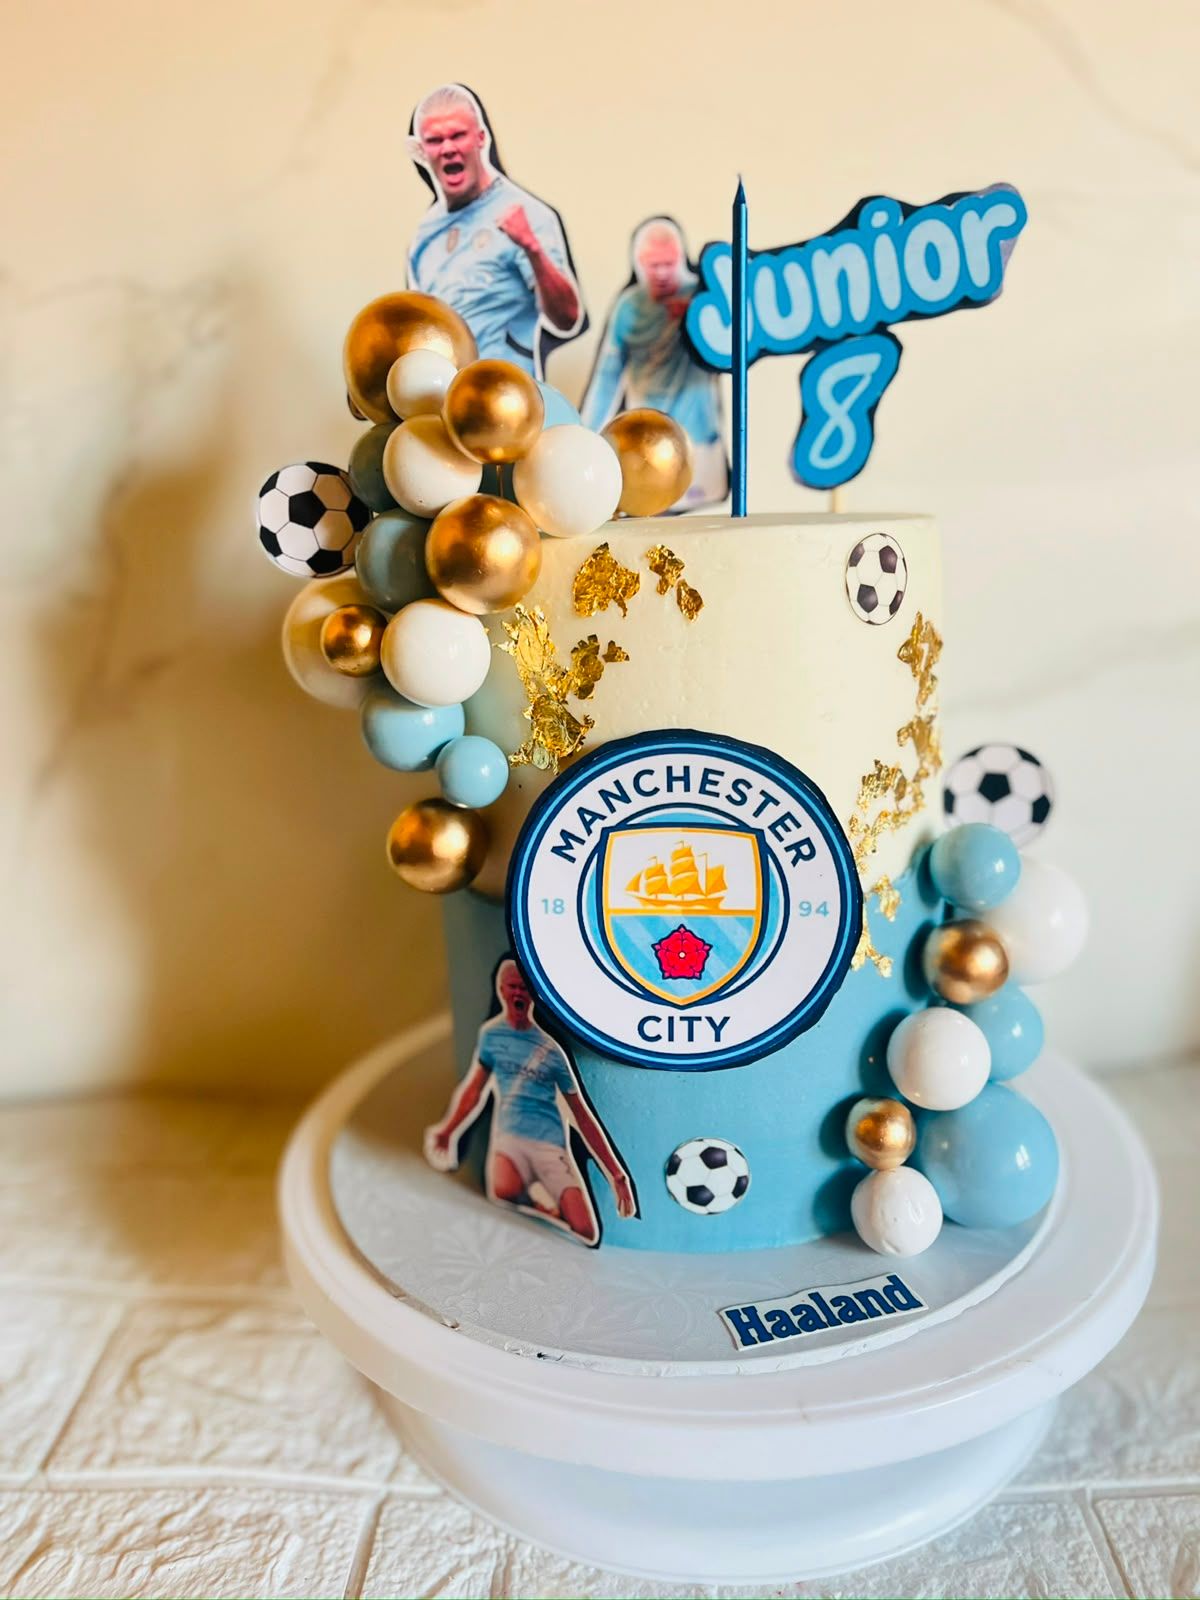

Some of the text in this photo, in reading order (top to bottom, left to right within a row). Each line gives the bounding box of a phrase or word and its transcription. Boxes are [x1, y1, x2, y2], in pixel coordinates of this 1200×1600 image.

[699, 203, 1017, 355] Junior
[809, 353, 882, 469] 8
[550, 766, 817, 867] MANCHESTER
[541, 898, 829, 917] 18 94
[637, 1015, 730, 1042] CITY
[726, 1274, 923, 1347] Haaland
